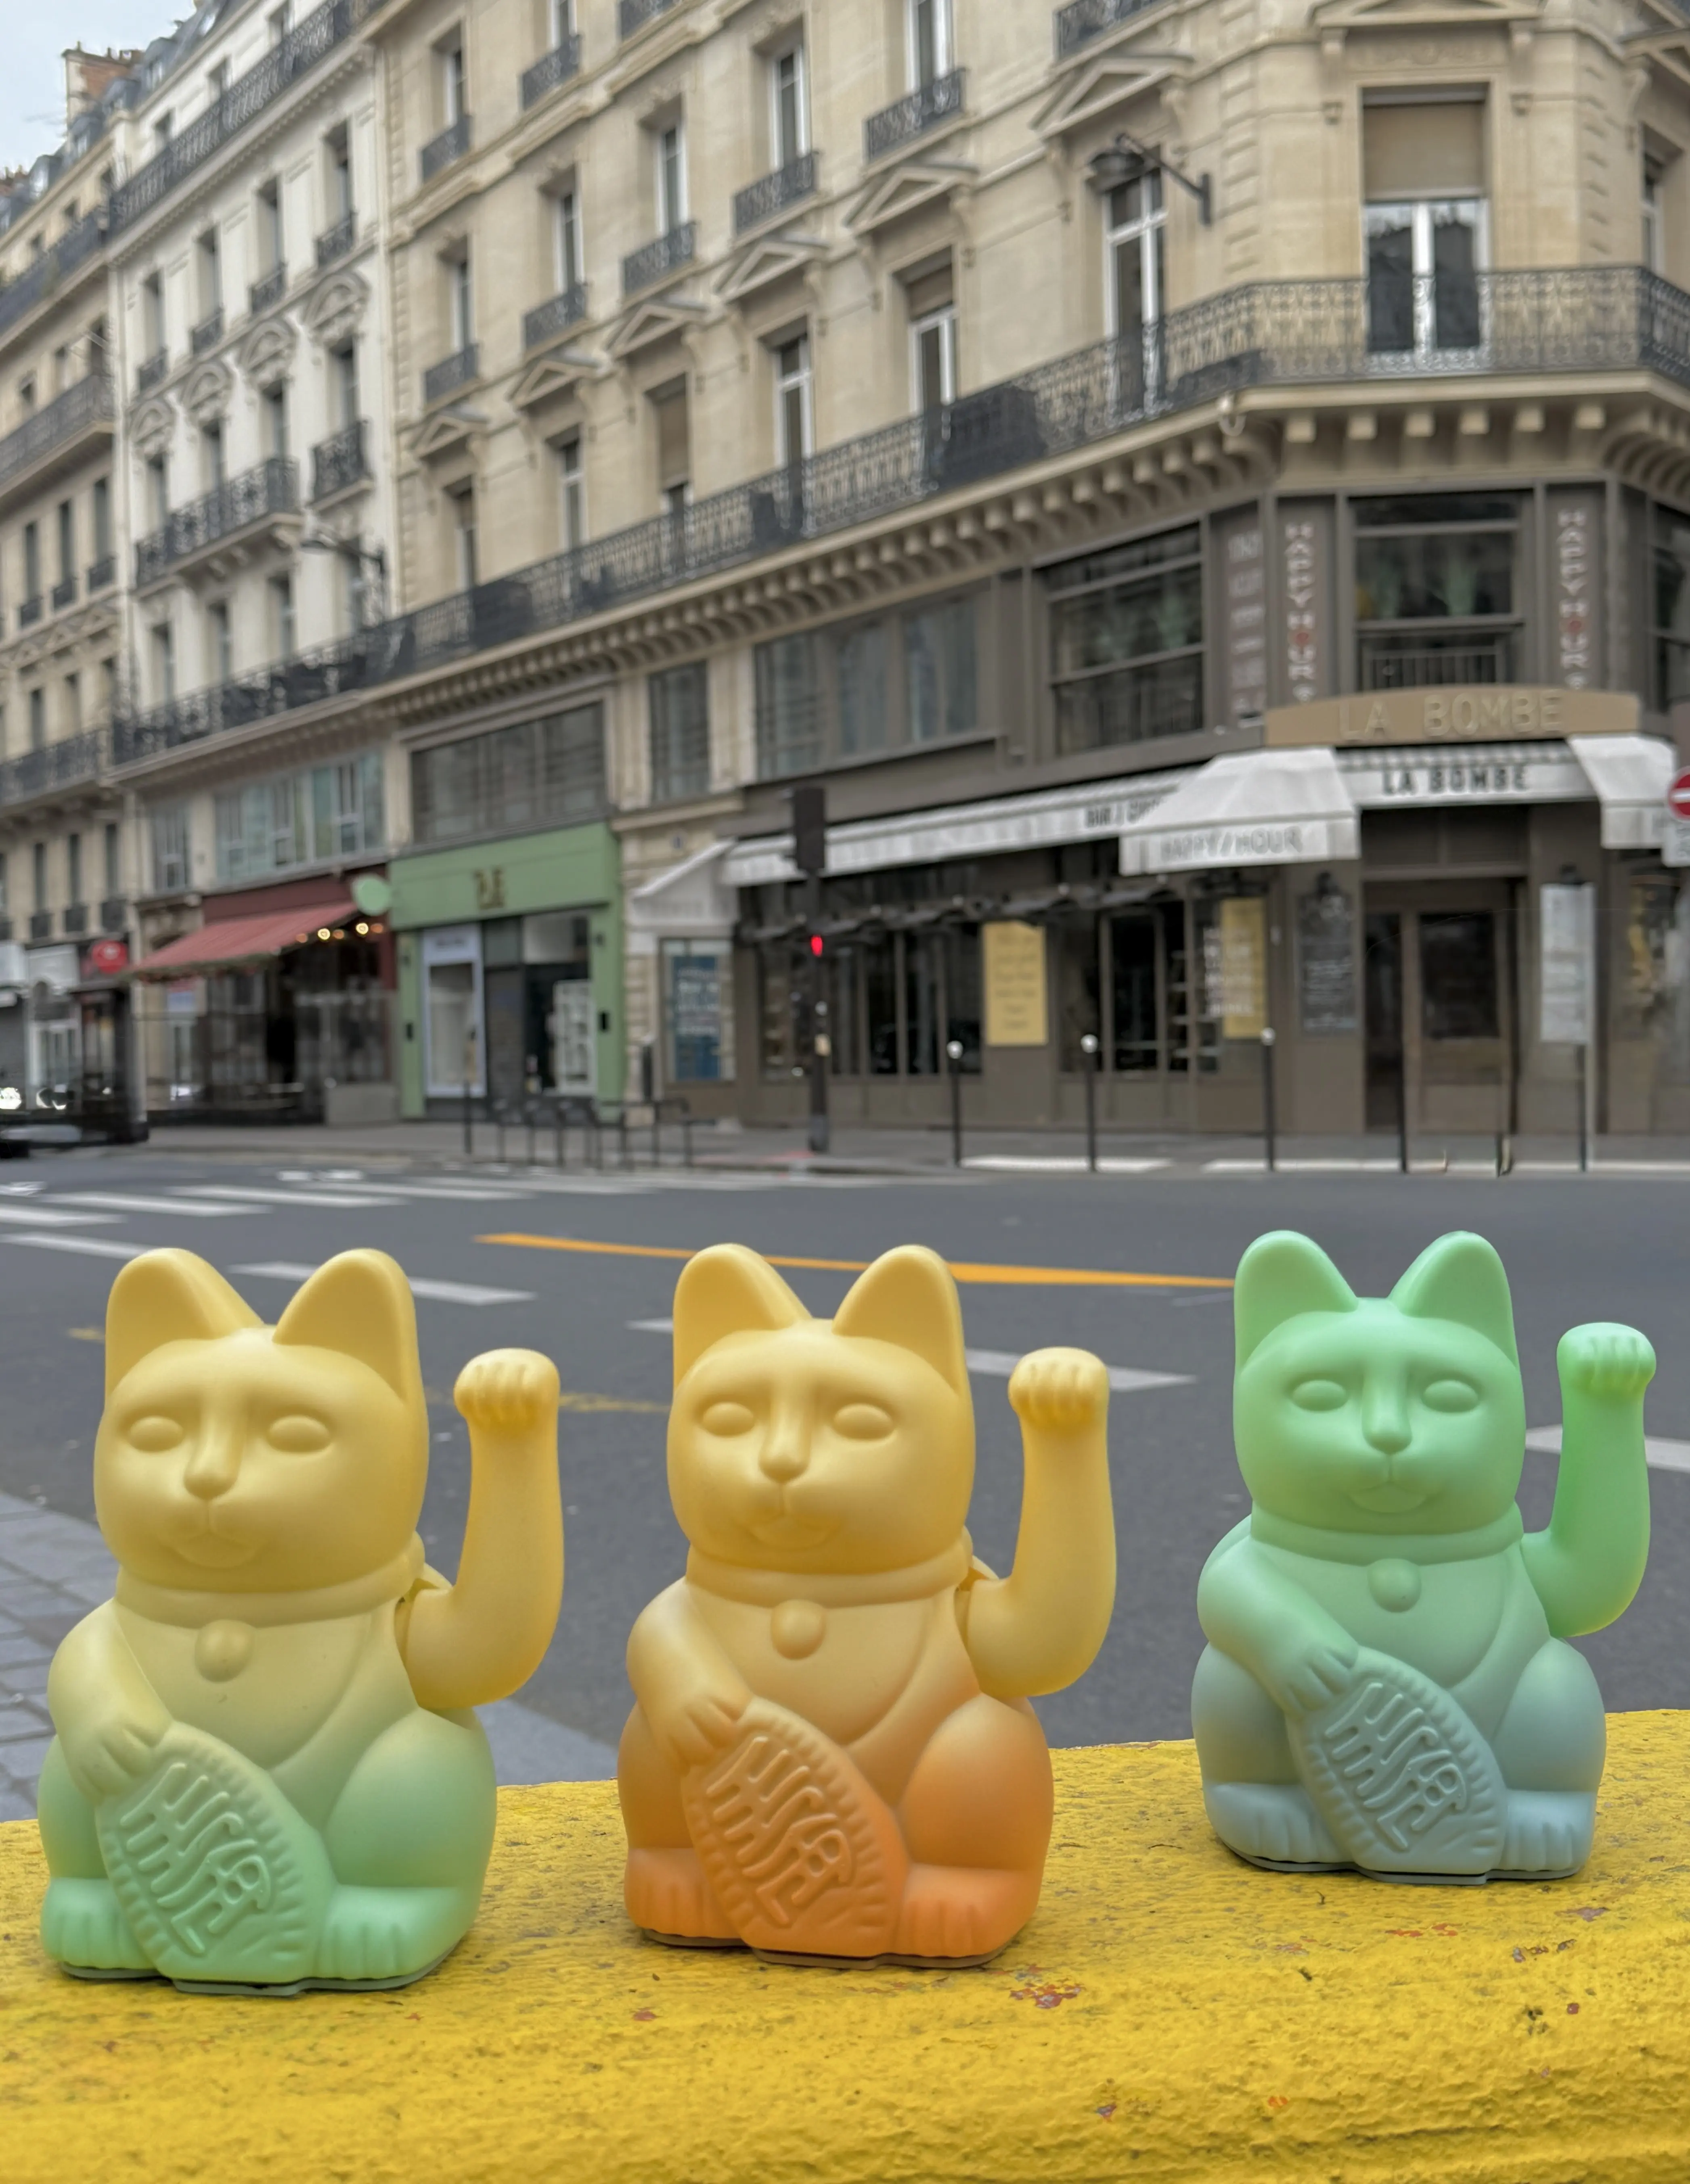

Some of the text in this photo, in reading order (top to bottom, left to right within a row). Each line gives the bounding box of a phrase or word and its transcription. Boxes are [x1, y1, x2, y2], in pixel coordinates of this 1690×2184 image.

[1285, 523, 1314, 608] HAPPY
[1557, 509, 1587, 596] HAPPY
[1338, 689, 1564, 741] LA BOMBE
[1382, 763, 1528, 795] LA BOMBE
